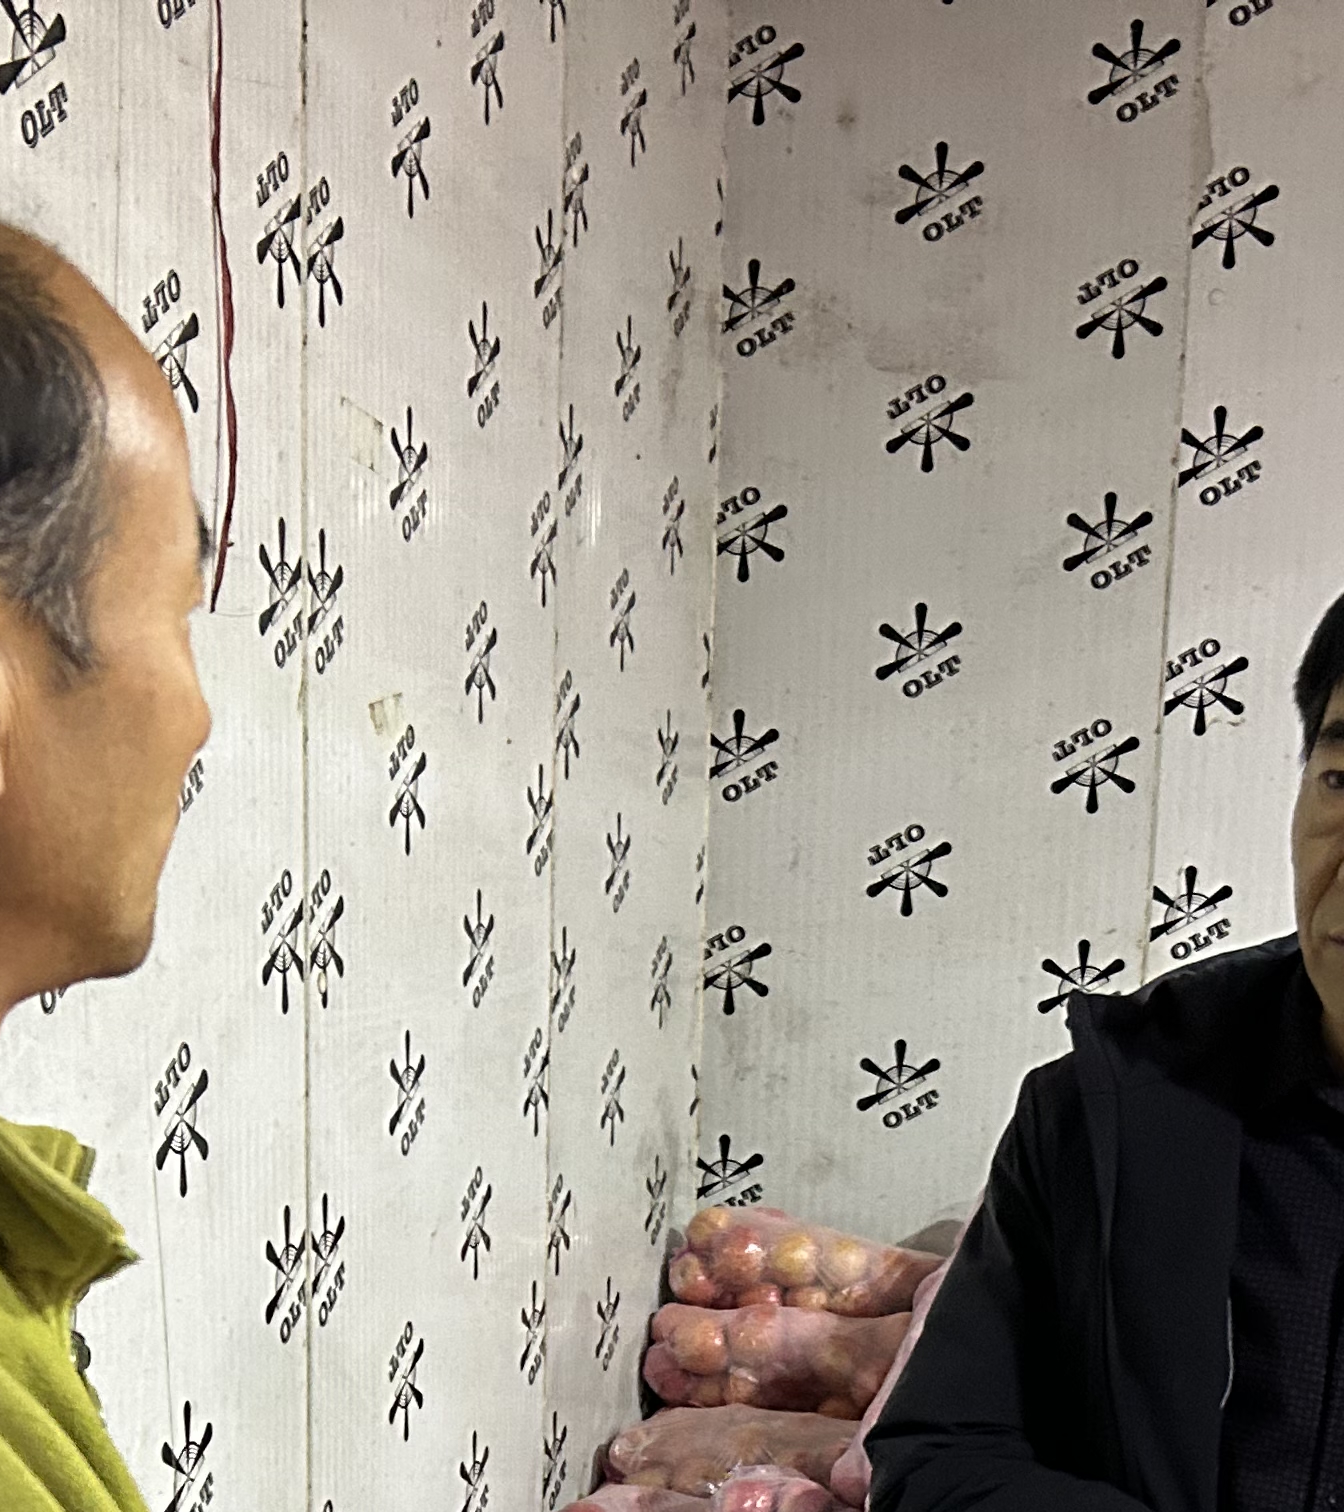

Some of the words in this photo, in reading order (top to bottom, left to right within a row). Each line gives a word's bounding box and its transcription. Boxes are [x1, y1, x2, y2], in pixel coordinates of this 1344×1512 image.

[1229, 0, 1273, 26] OL
[21, 83, 67, 147] OLT
[391, 78, 419, 125] OLT
[1116, 75, 1179, 122] OLT
[257, 151, 289, 207] OLT
[923, 196, 983, 241] OLT
[142, 269, 180, 333] OLT
[1077, 259, 1139, 304] OLT
[737, 313, 795, 356] OLT
[887, 375, 946, 419] OLT
[1199, 460, 1261, 504] OLT
[402, 489, 427, 541] OLT
[717, 487, 760, 524] OL
[1091, 545, 1151, 589] OLT
[315, 616, 344, 673] OLT
[1164, 638, 1221, 681] OLT
[902, 655, 961, 697] OLT
[390, 724, 415, 780] OLT
[1052, 719, 1112, 761] OLT
[722, 761, 778, 801] OLT
[868, 824, 926, 865] OLT
[262, 870, 292, 933] OLT
[704, 925, 745, 961] OL
[1170, 919, 1231, 960] OLT
[155, 1042, 191, 1115] OLT
[402, 1098, 425, 1155] OLT
[883, 1089, 939, 1128] OLT
[318, 1262, 345, 1326] OLT
[390, 1321, 413, 1382] OLT
